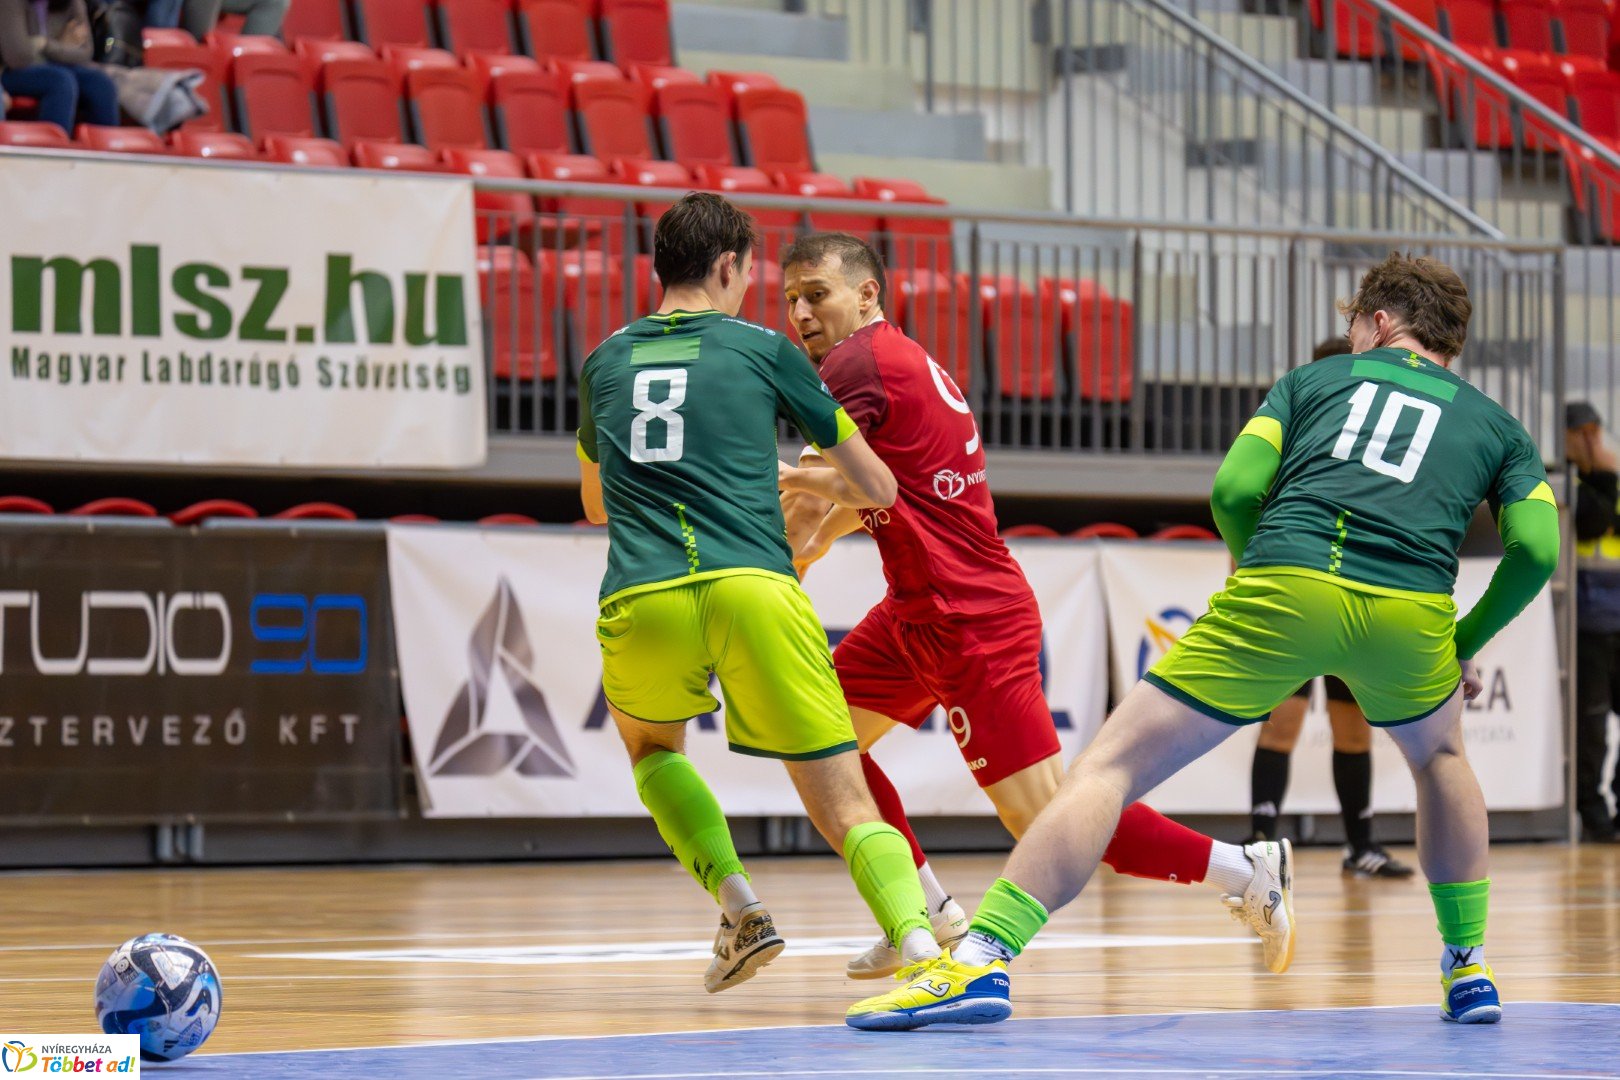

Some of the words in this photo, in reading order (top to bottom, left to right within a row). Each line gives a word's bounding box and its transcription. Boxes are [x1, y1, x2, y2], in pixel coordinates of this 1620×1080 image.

[11, 243, 468, 347] mlsz.hu
[12, 346, 127, 385] Magyar
[142, 350, 301, 392] Labdarúgó
[317, 356, 472, 394] Szövetség
[630, 368, 688, 463] 8
[1331, 381, 1442, 483] 10
[250, 593, 368, 675] 90
[278, 714, 361, 746] KFT
[948, 706, 971, 749] 9
[967, 757, 987, 771] AKO
